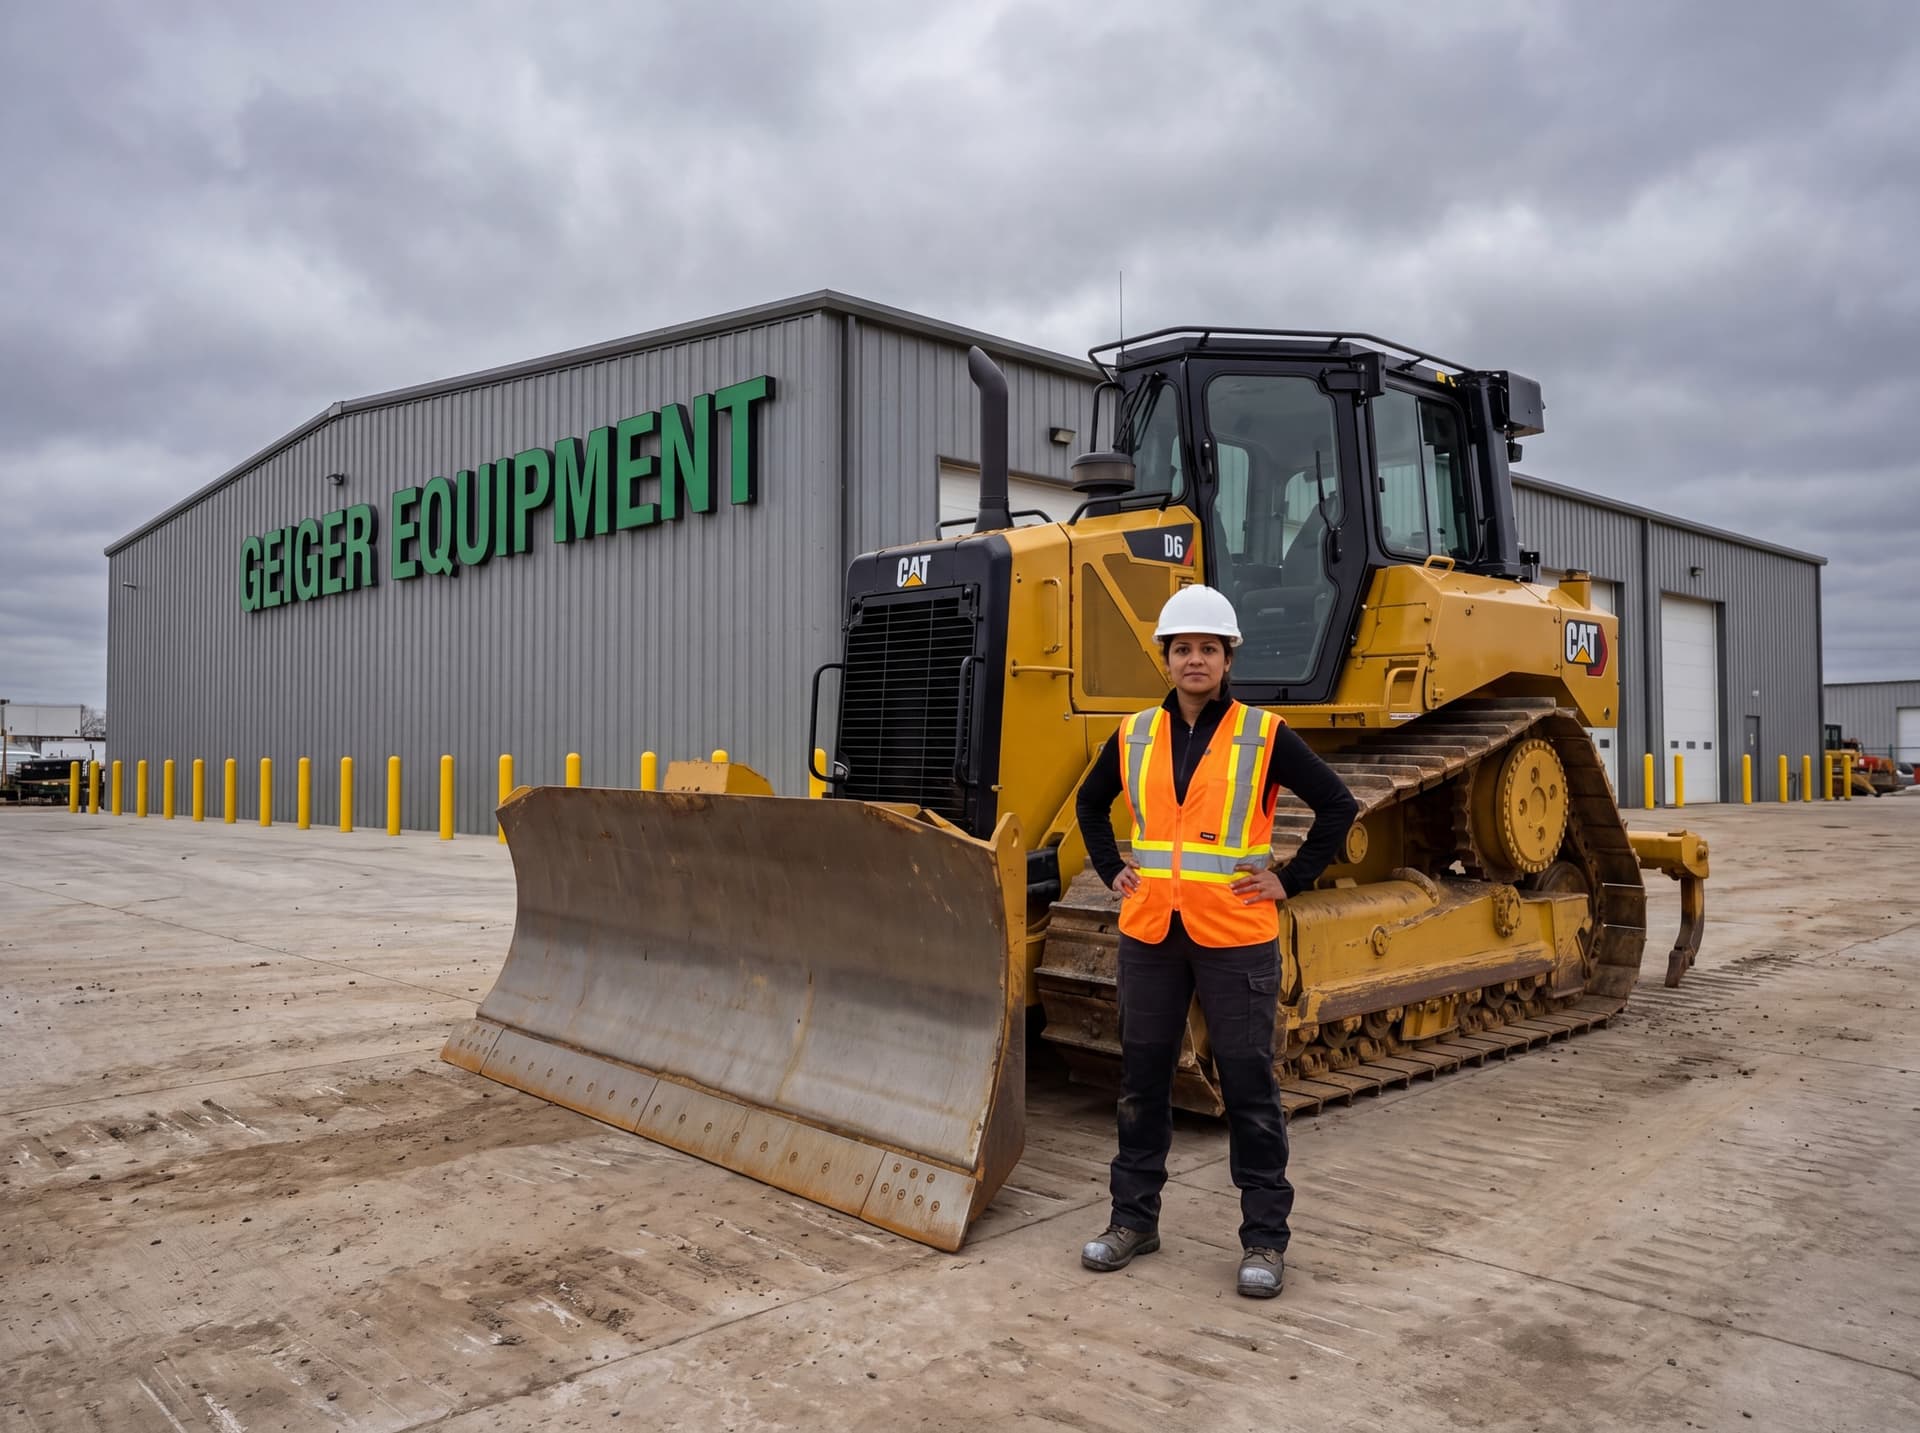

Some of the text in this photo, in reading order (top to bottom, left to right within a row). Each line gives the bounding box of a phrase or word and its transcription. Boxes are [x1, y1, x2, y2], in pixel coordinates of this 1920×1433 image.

[239, 375, 775, 613] GEIGER EQUIPMENT
[1164, 534, 1183, 558] D6
[897, 555, 931, 588] CAT
[1566, 622, 1597, 664] CAT
